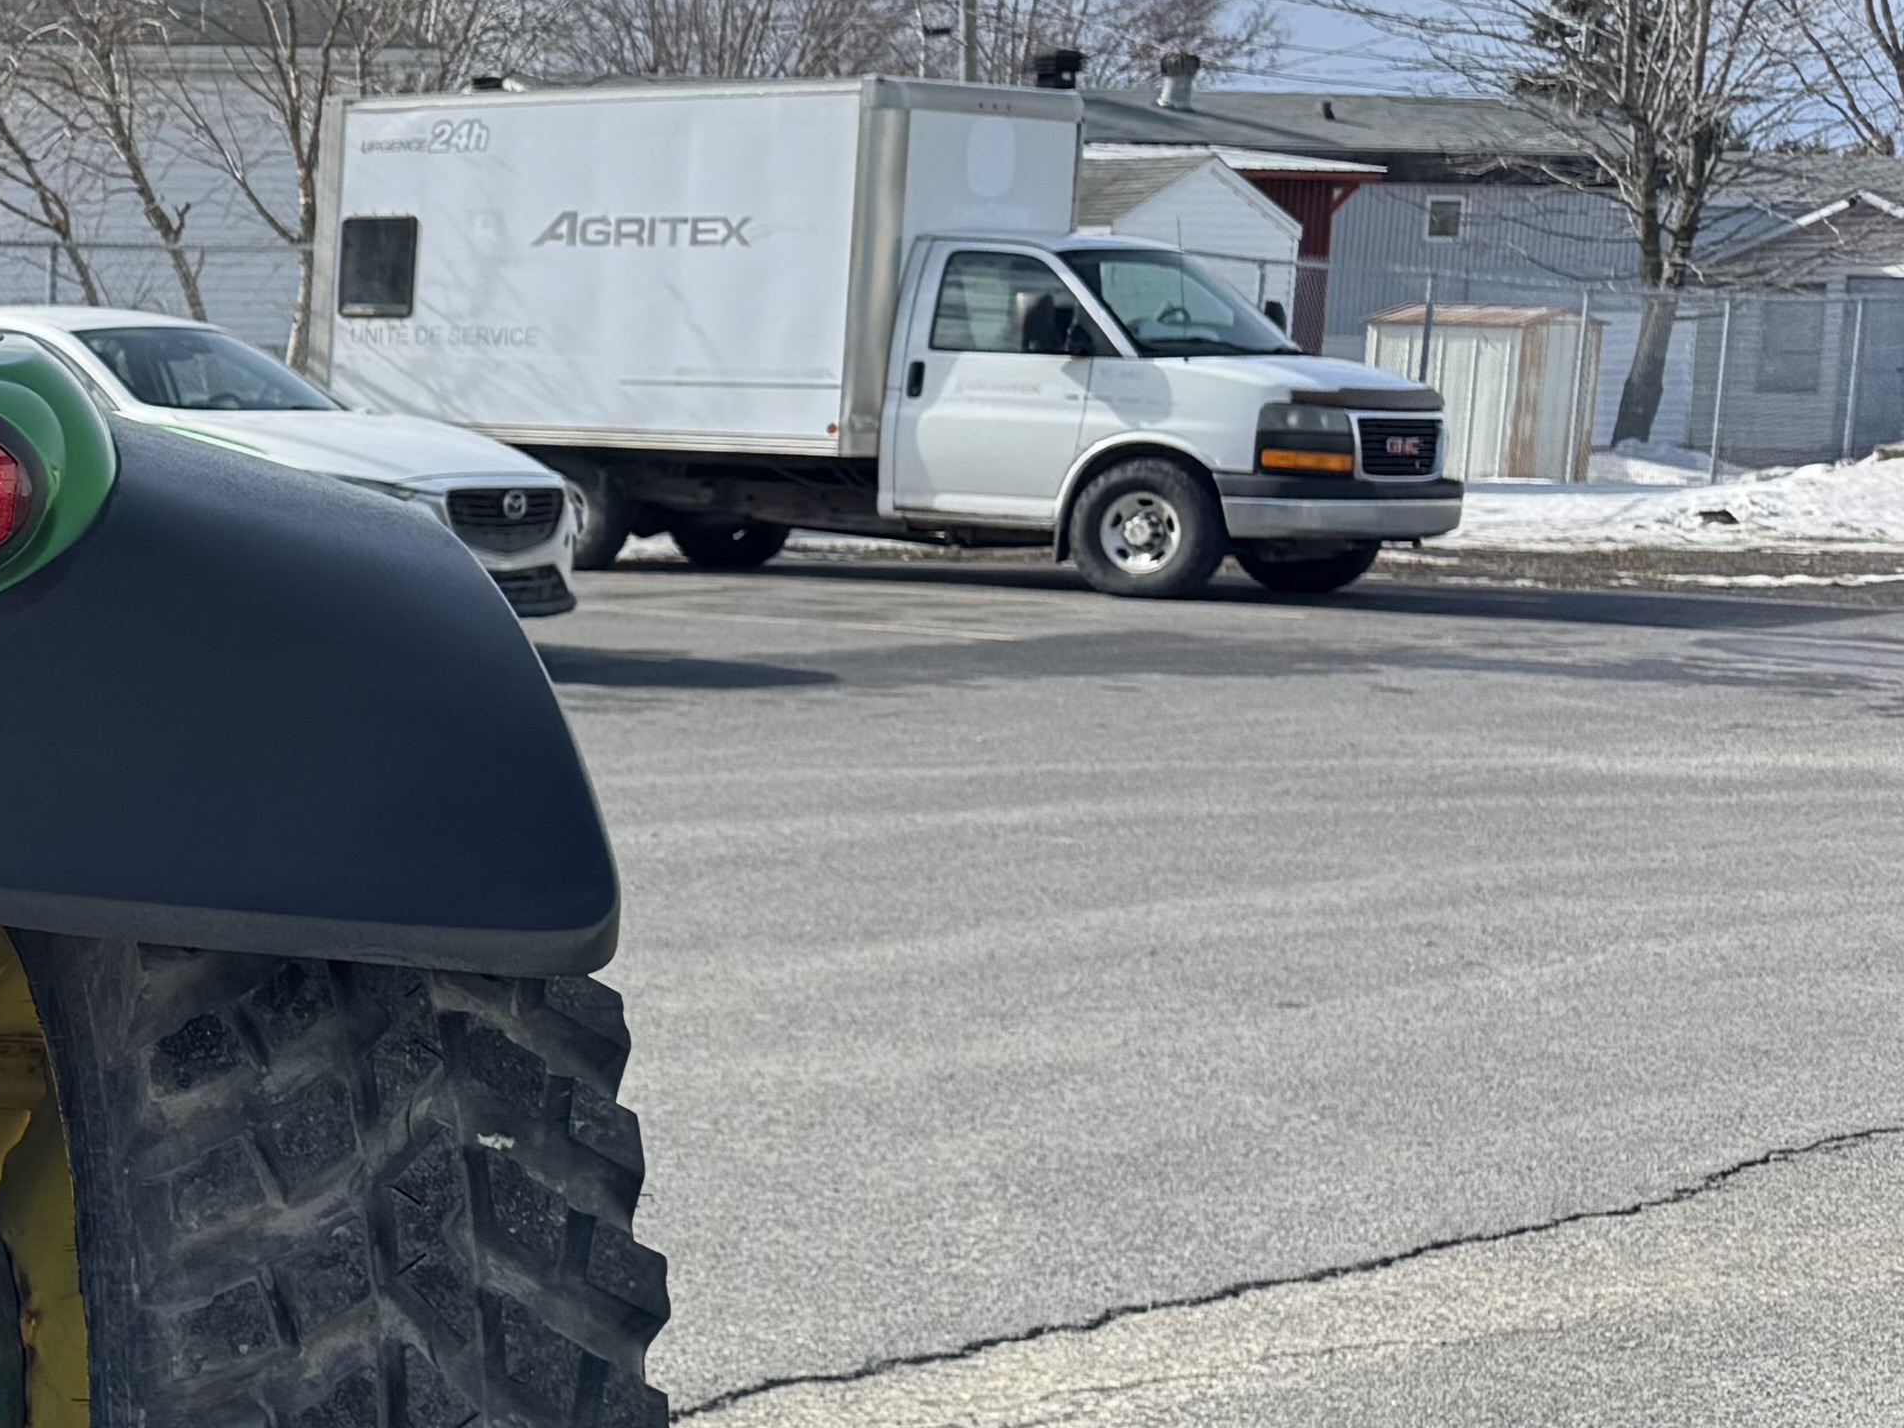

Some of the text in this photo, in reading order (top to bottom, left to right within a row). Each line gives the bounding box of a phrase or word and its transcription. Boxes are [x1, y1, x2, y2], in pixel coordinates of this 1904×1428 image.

[427, 118, 490, 154] 24h
[530, 210, 752, 247] AGRITEX
[415, 325, 442, 347] DE
[447, 324, 539, 348] SERVICE
